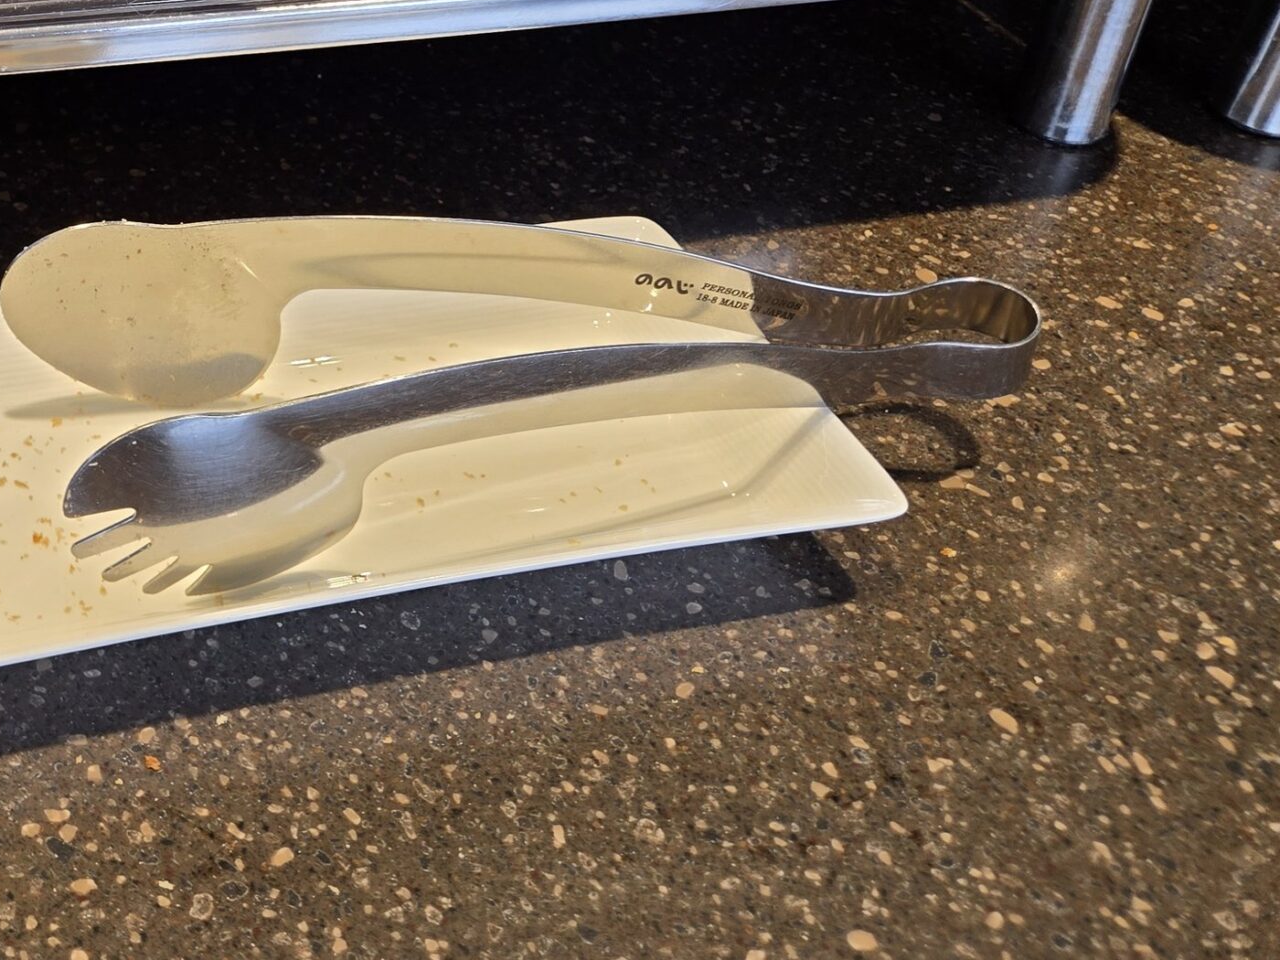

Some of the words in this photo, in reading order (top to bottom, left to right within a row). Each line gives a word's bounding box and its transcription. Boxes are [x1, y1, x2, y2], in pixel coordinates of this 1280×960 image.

[696, 292, 718, 304] 18-8
[719, 298, 749, 311] MADE
[749, 304, 761, 314] IN
[761, 307, 795, 321] JAPAN
